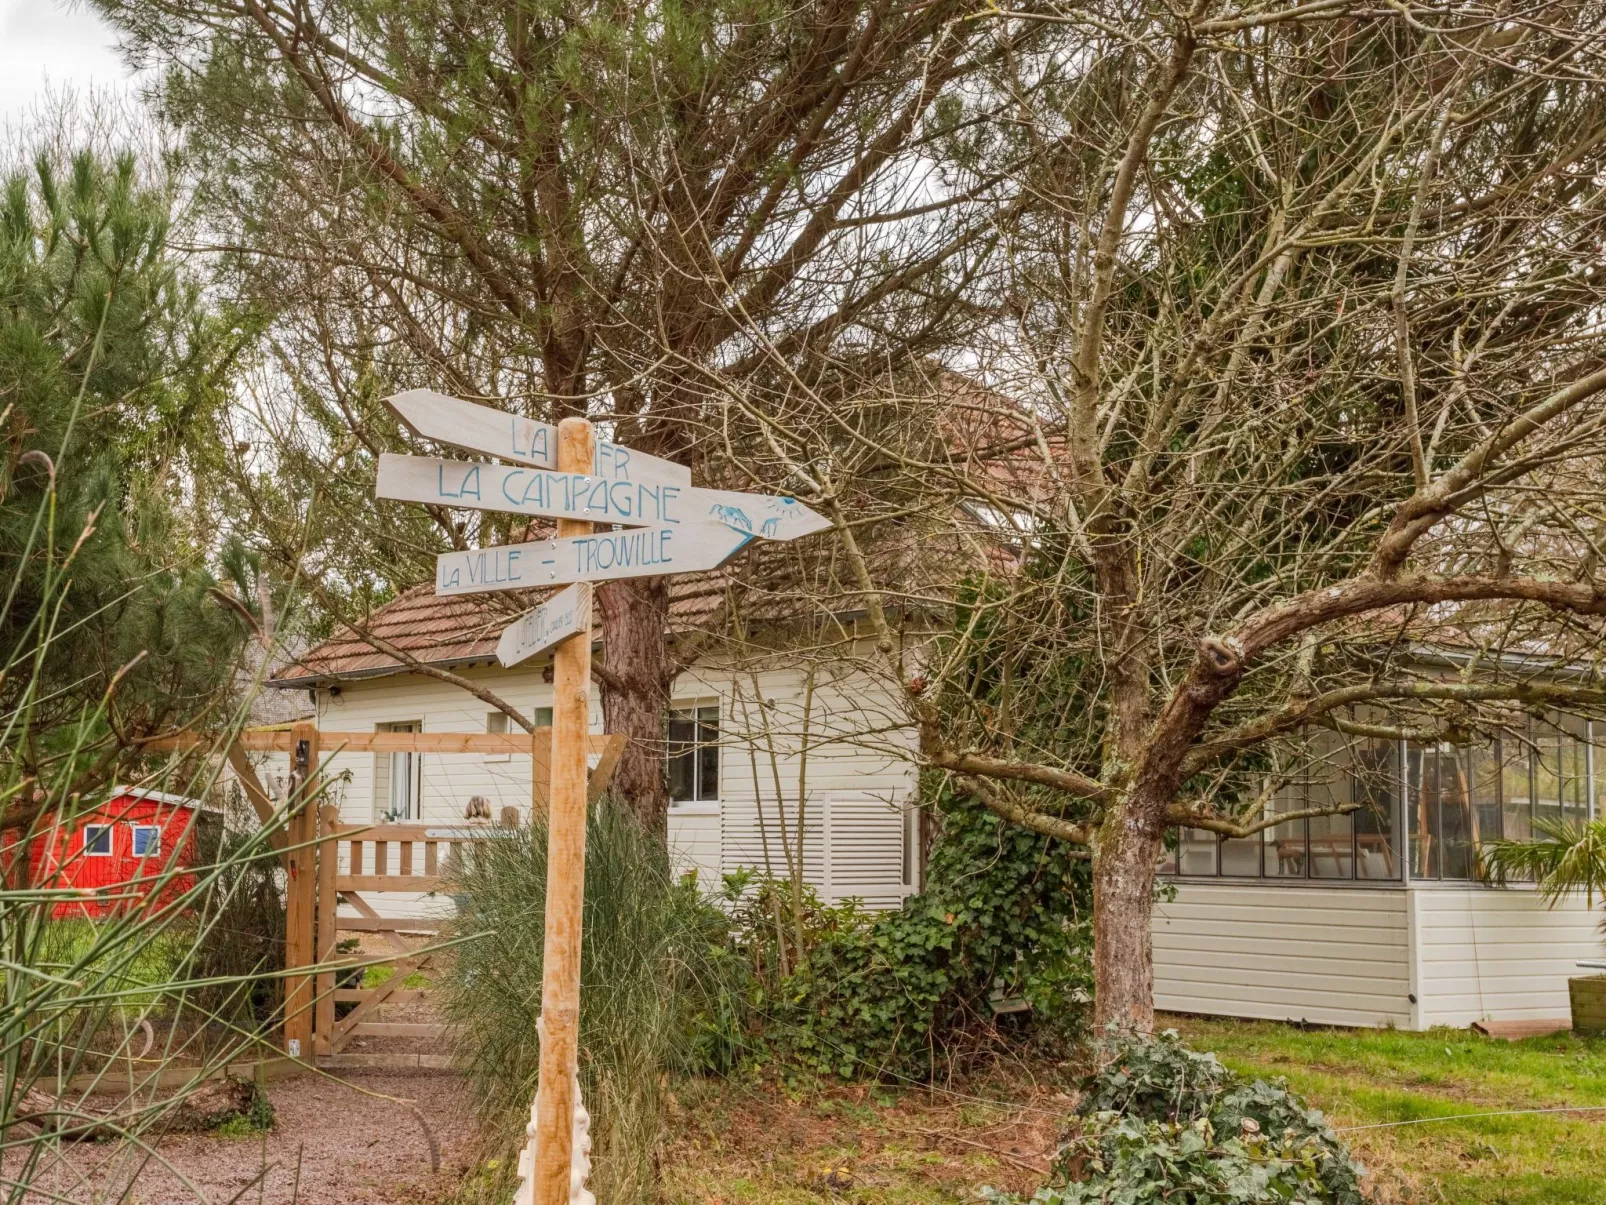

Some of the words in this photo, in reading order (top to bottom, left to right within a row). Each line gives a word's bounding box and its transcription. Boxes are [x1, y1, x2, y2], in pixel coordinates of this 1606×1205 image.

[511, 418, 549, 462] LA
[593, 440, 631, 480] ER
[438, 463, 481, 501] LA
[502, 470, 681, 524] CAMPAGNE
[466, 550, 522, 584] VILLE
[571, 529, 673, 573] TROUVILLE
